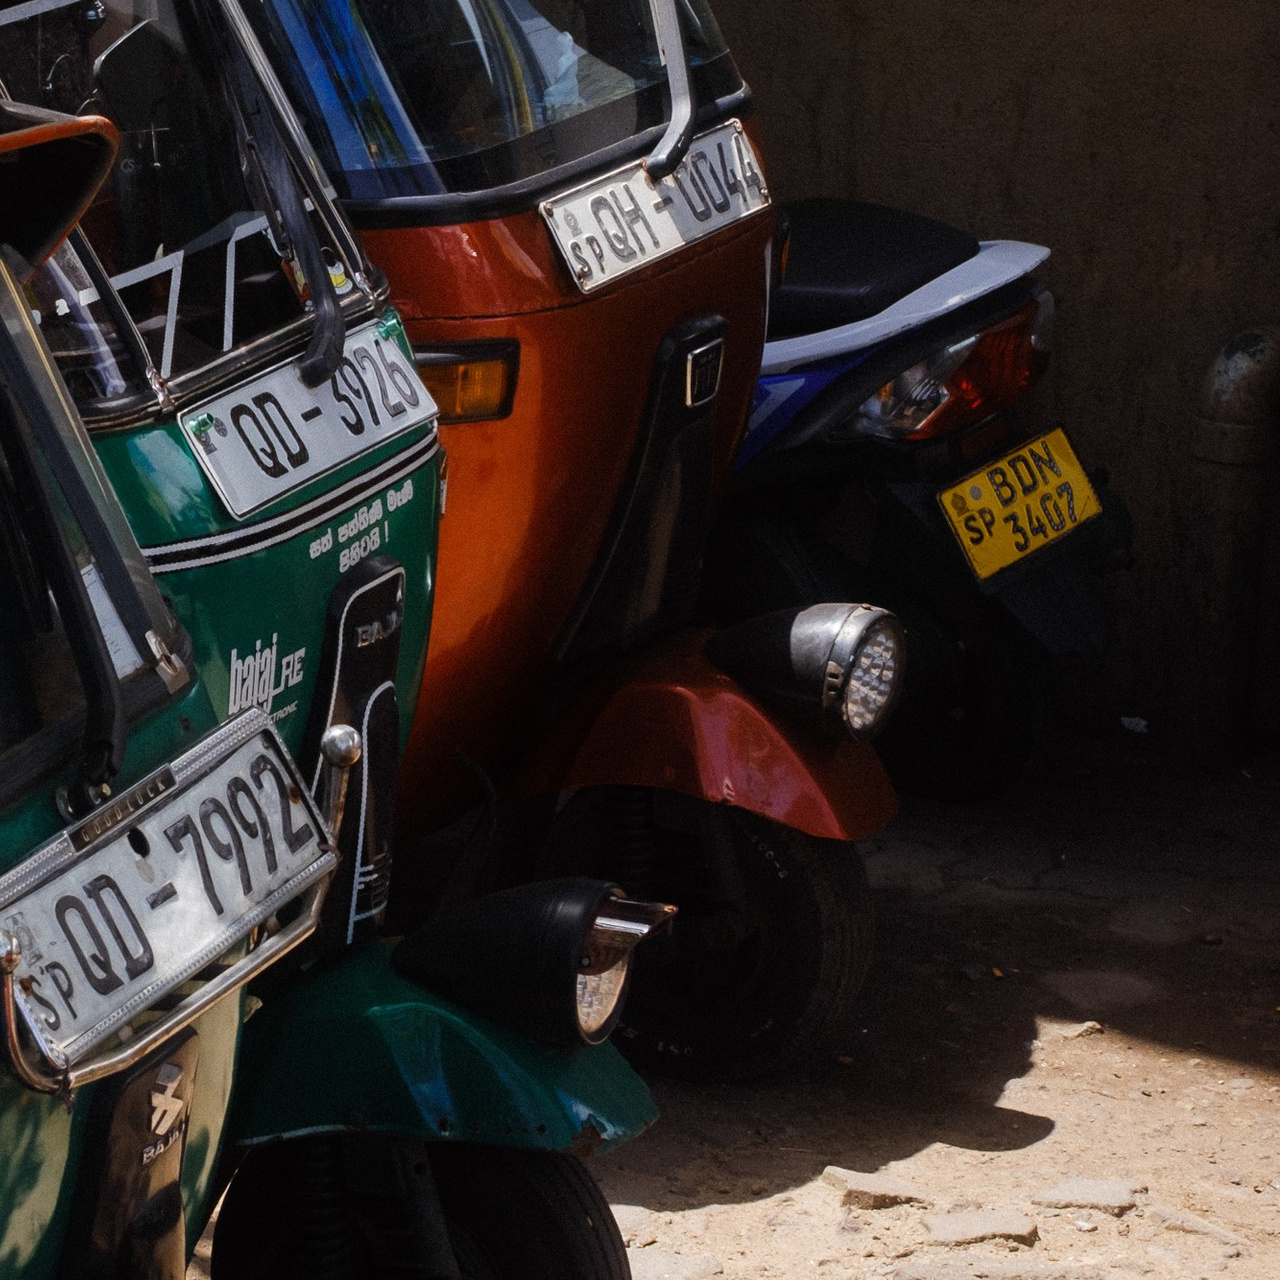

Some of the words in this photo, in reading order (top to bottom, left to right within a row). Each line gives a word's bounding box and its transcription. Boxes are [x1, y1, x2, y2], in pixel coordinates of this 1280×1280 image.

[569, 234, 606, 278] SP
[986, 440, 1063, 508] BDN
[963, 506, 996, 546] SP
[1003, 481, 1078, 553] 3407
[27, 962, 75, 1032] SP
